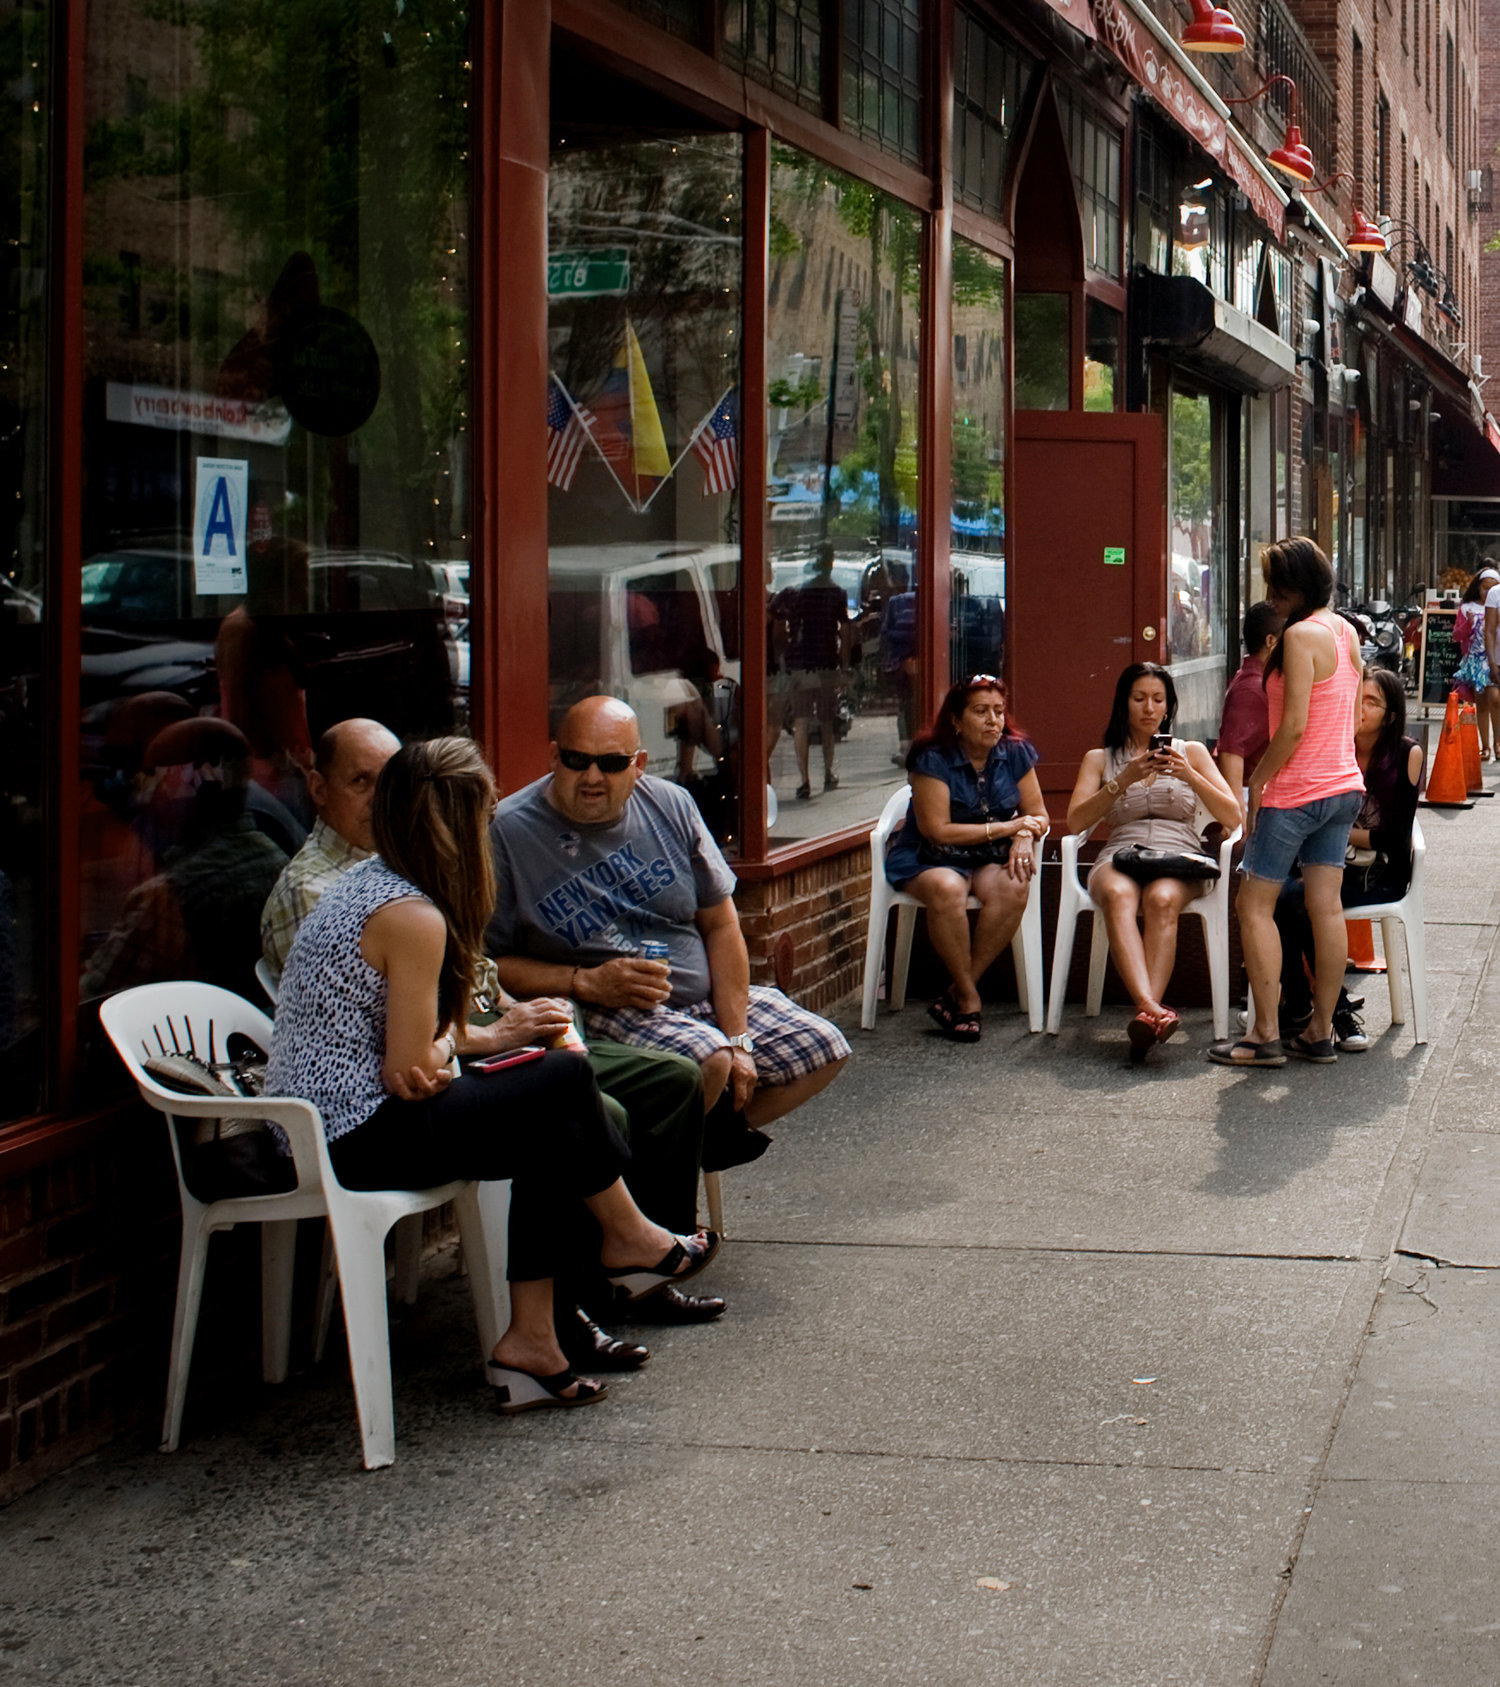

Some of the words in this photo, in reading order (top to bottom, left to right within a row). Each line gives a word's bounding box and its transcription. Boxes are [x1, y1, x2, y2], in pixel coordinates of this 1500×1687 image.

[202, 476, 237, 556] A
[536, 876, 590, 928] NEW
[580, 840, 648, 889] YORK
[553, 857, 677, 948] YANKEES
